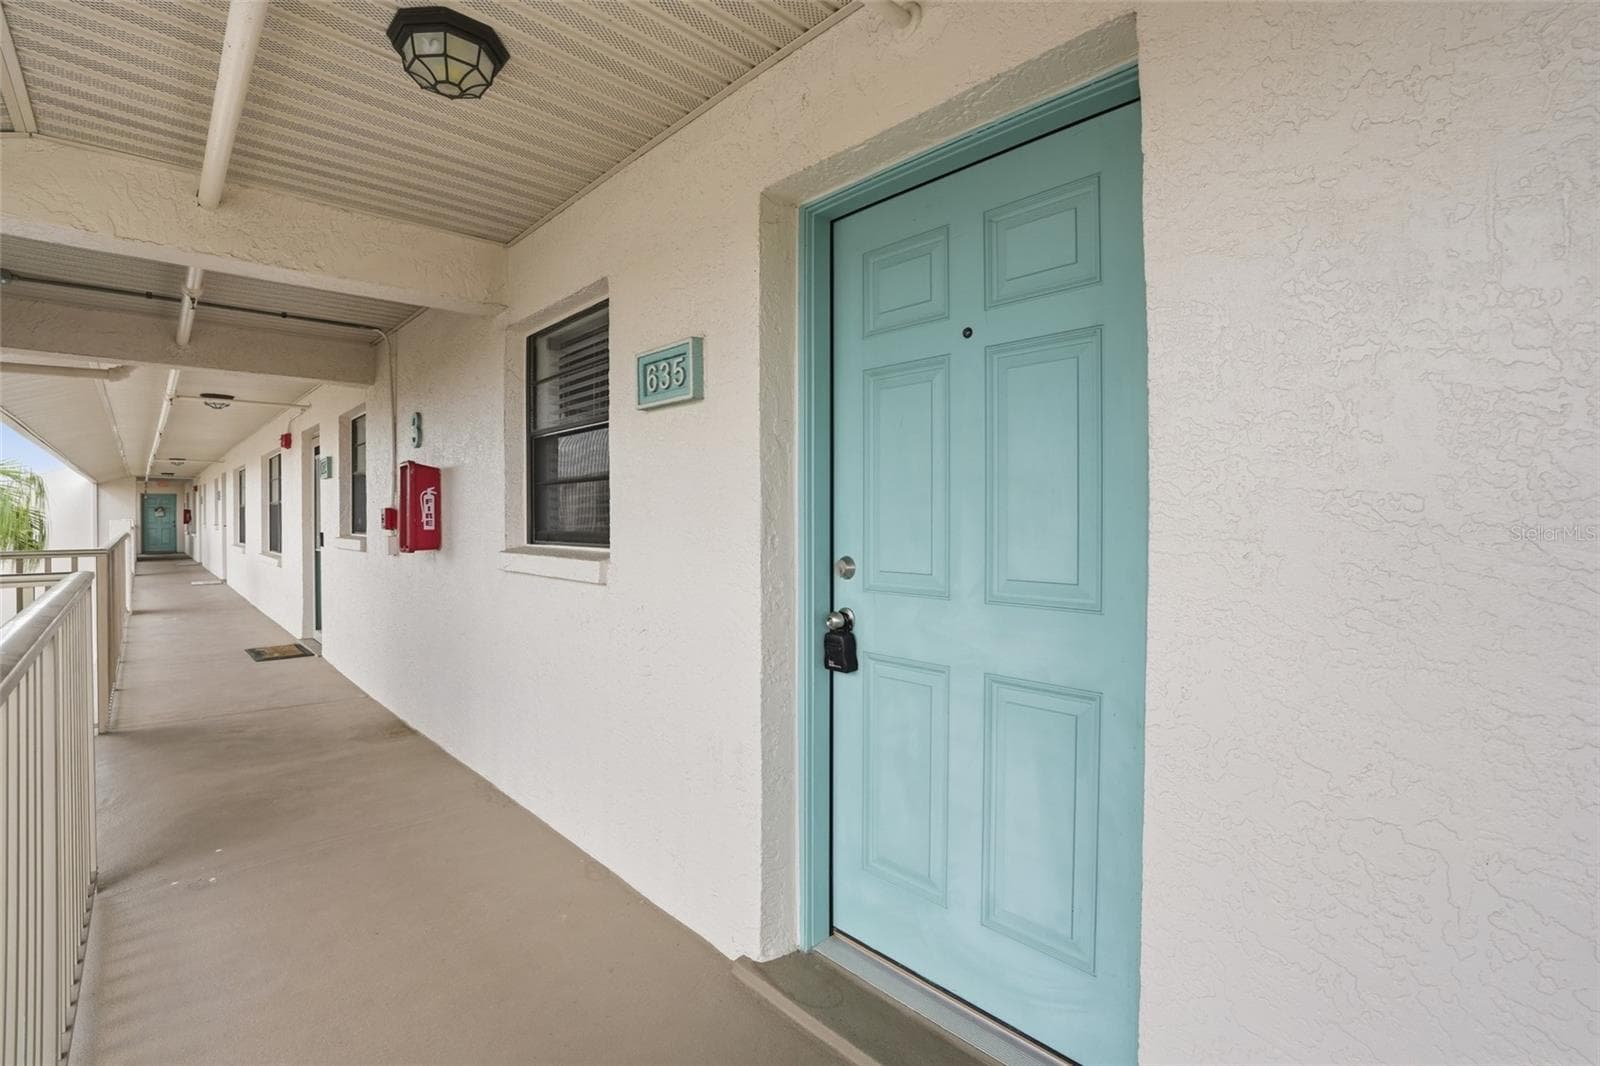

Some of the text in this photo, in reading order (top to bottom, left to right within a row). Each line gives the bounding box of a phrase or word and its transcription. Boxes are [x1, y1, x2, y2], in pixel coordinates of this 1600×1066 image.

[647, 357, 686, 392] 635
[412, 412, 423, 448] 3
[425, 498, 433, 527] FIRE
